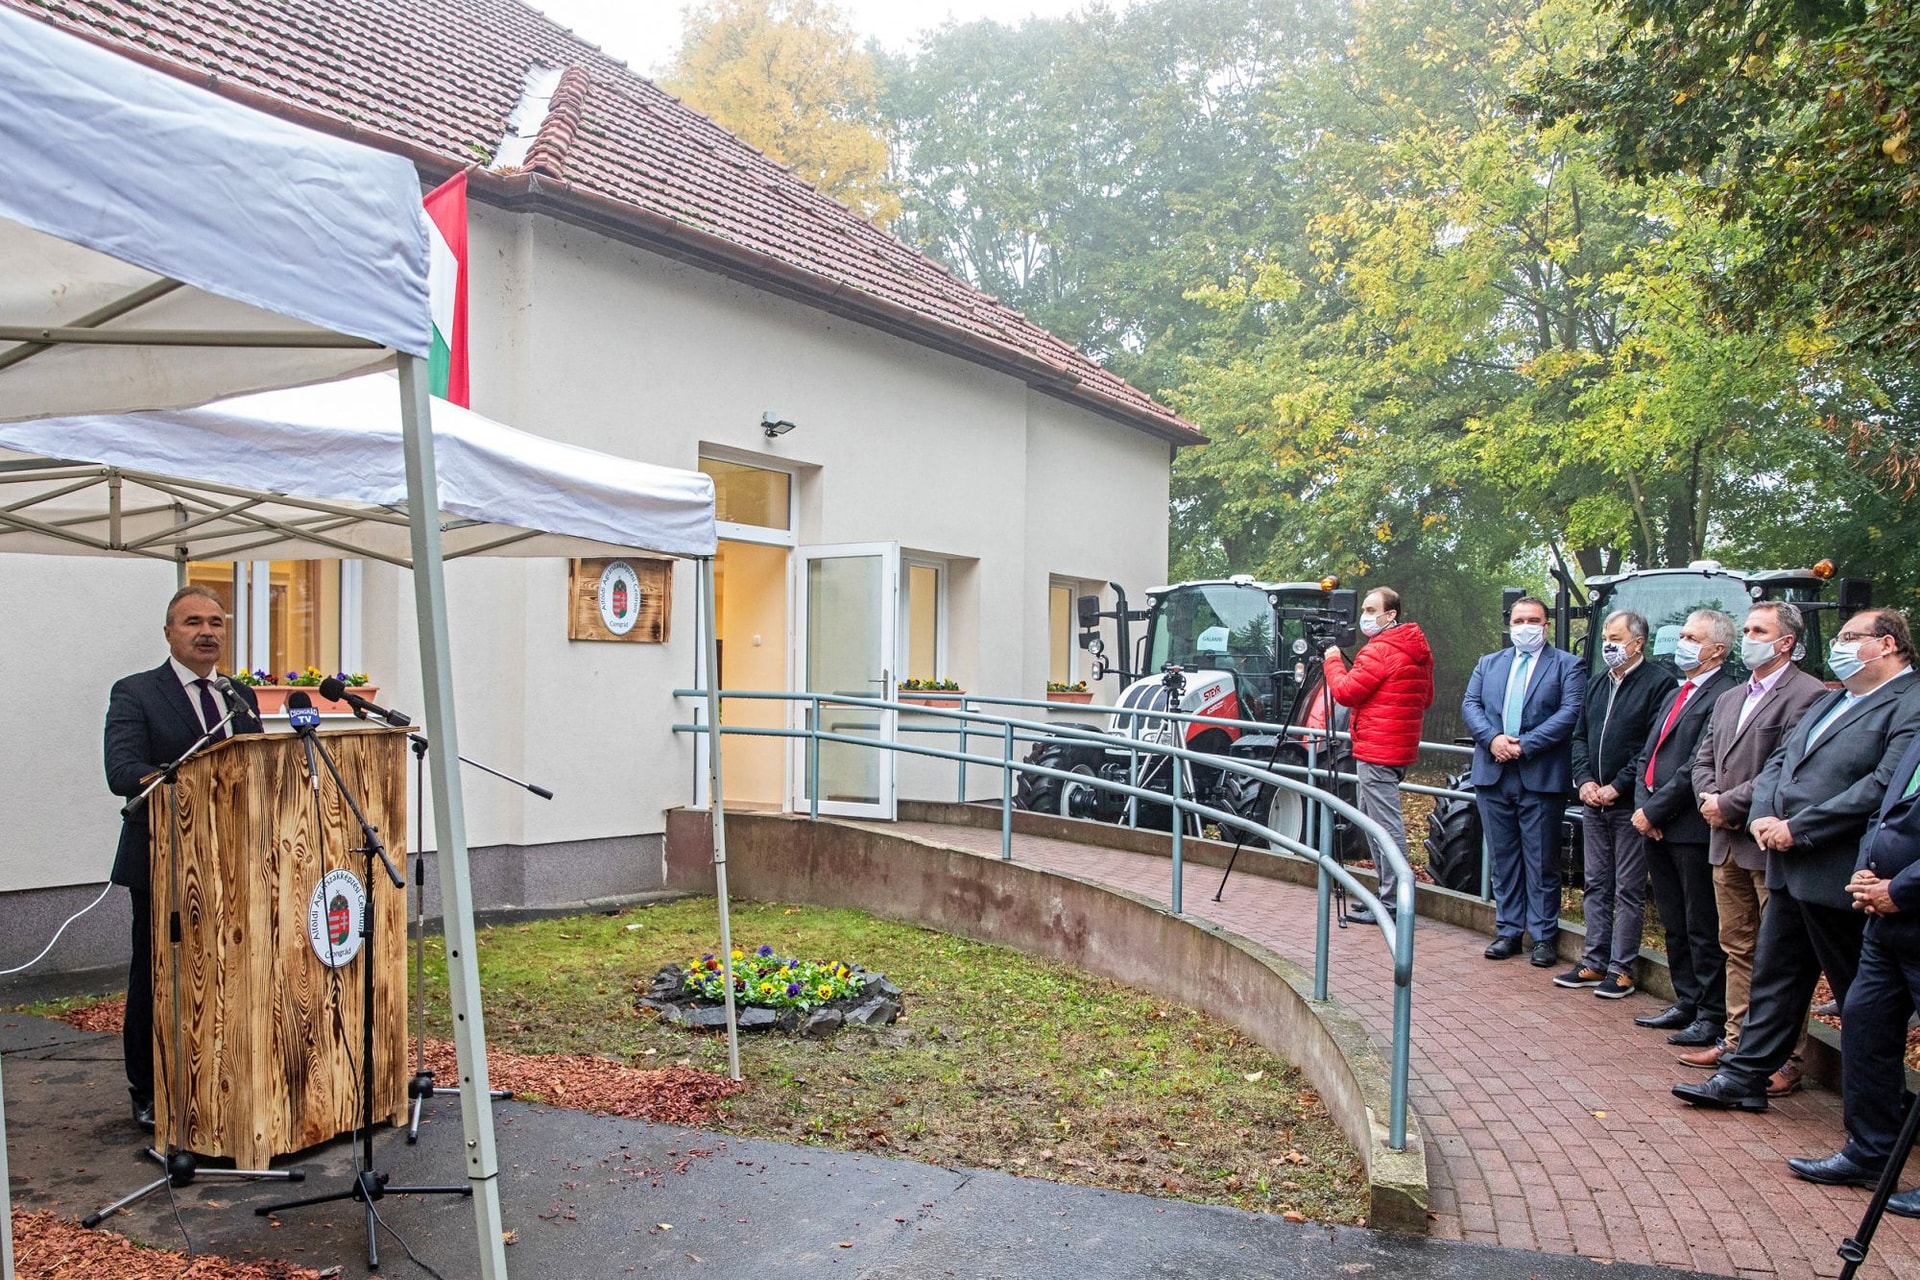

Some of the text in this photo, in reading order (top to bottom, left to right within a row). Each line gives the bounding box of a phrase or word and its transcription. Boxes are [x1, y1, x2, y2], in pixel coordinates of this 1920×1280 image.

[1203, 685, 1221, 702] STEYR
[297, 715, 312, 724] TV
[314, 871, 362, 908] Agrrszakképzési
[324, 946, 352, 959] Congrád
